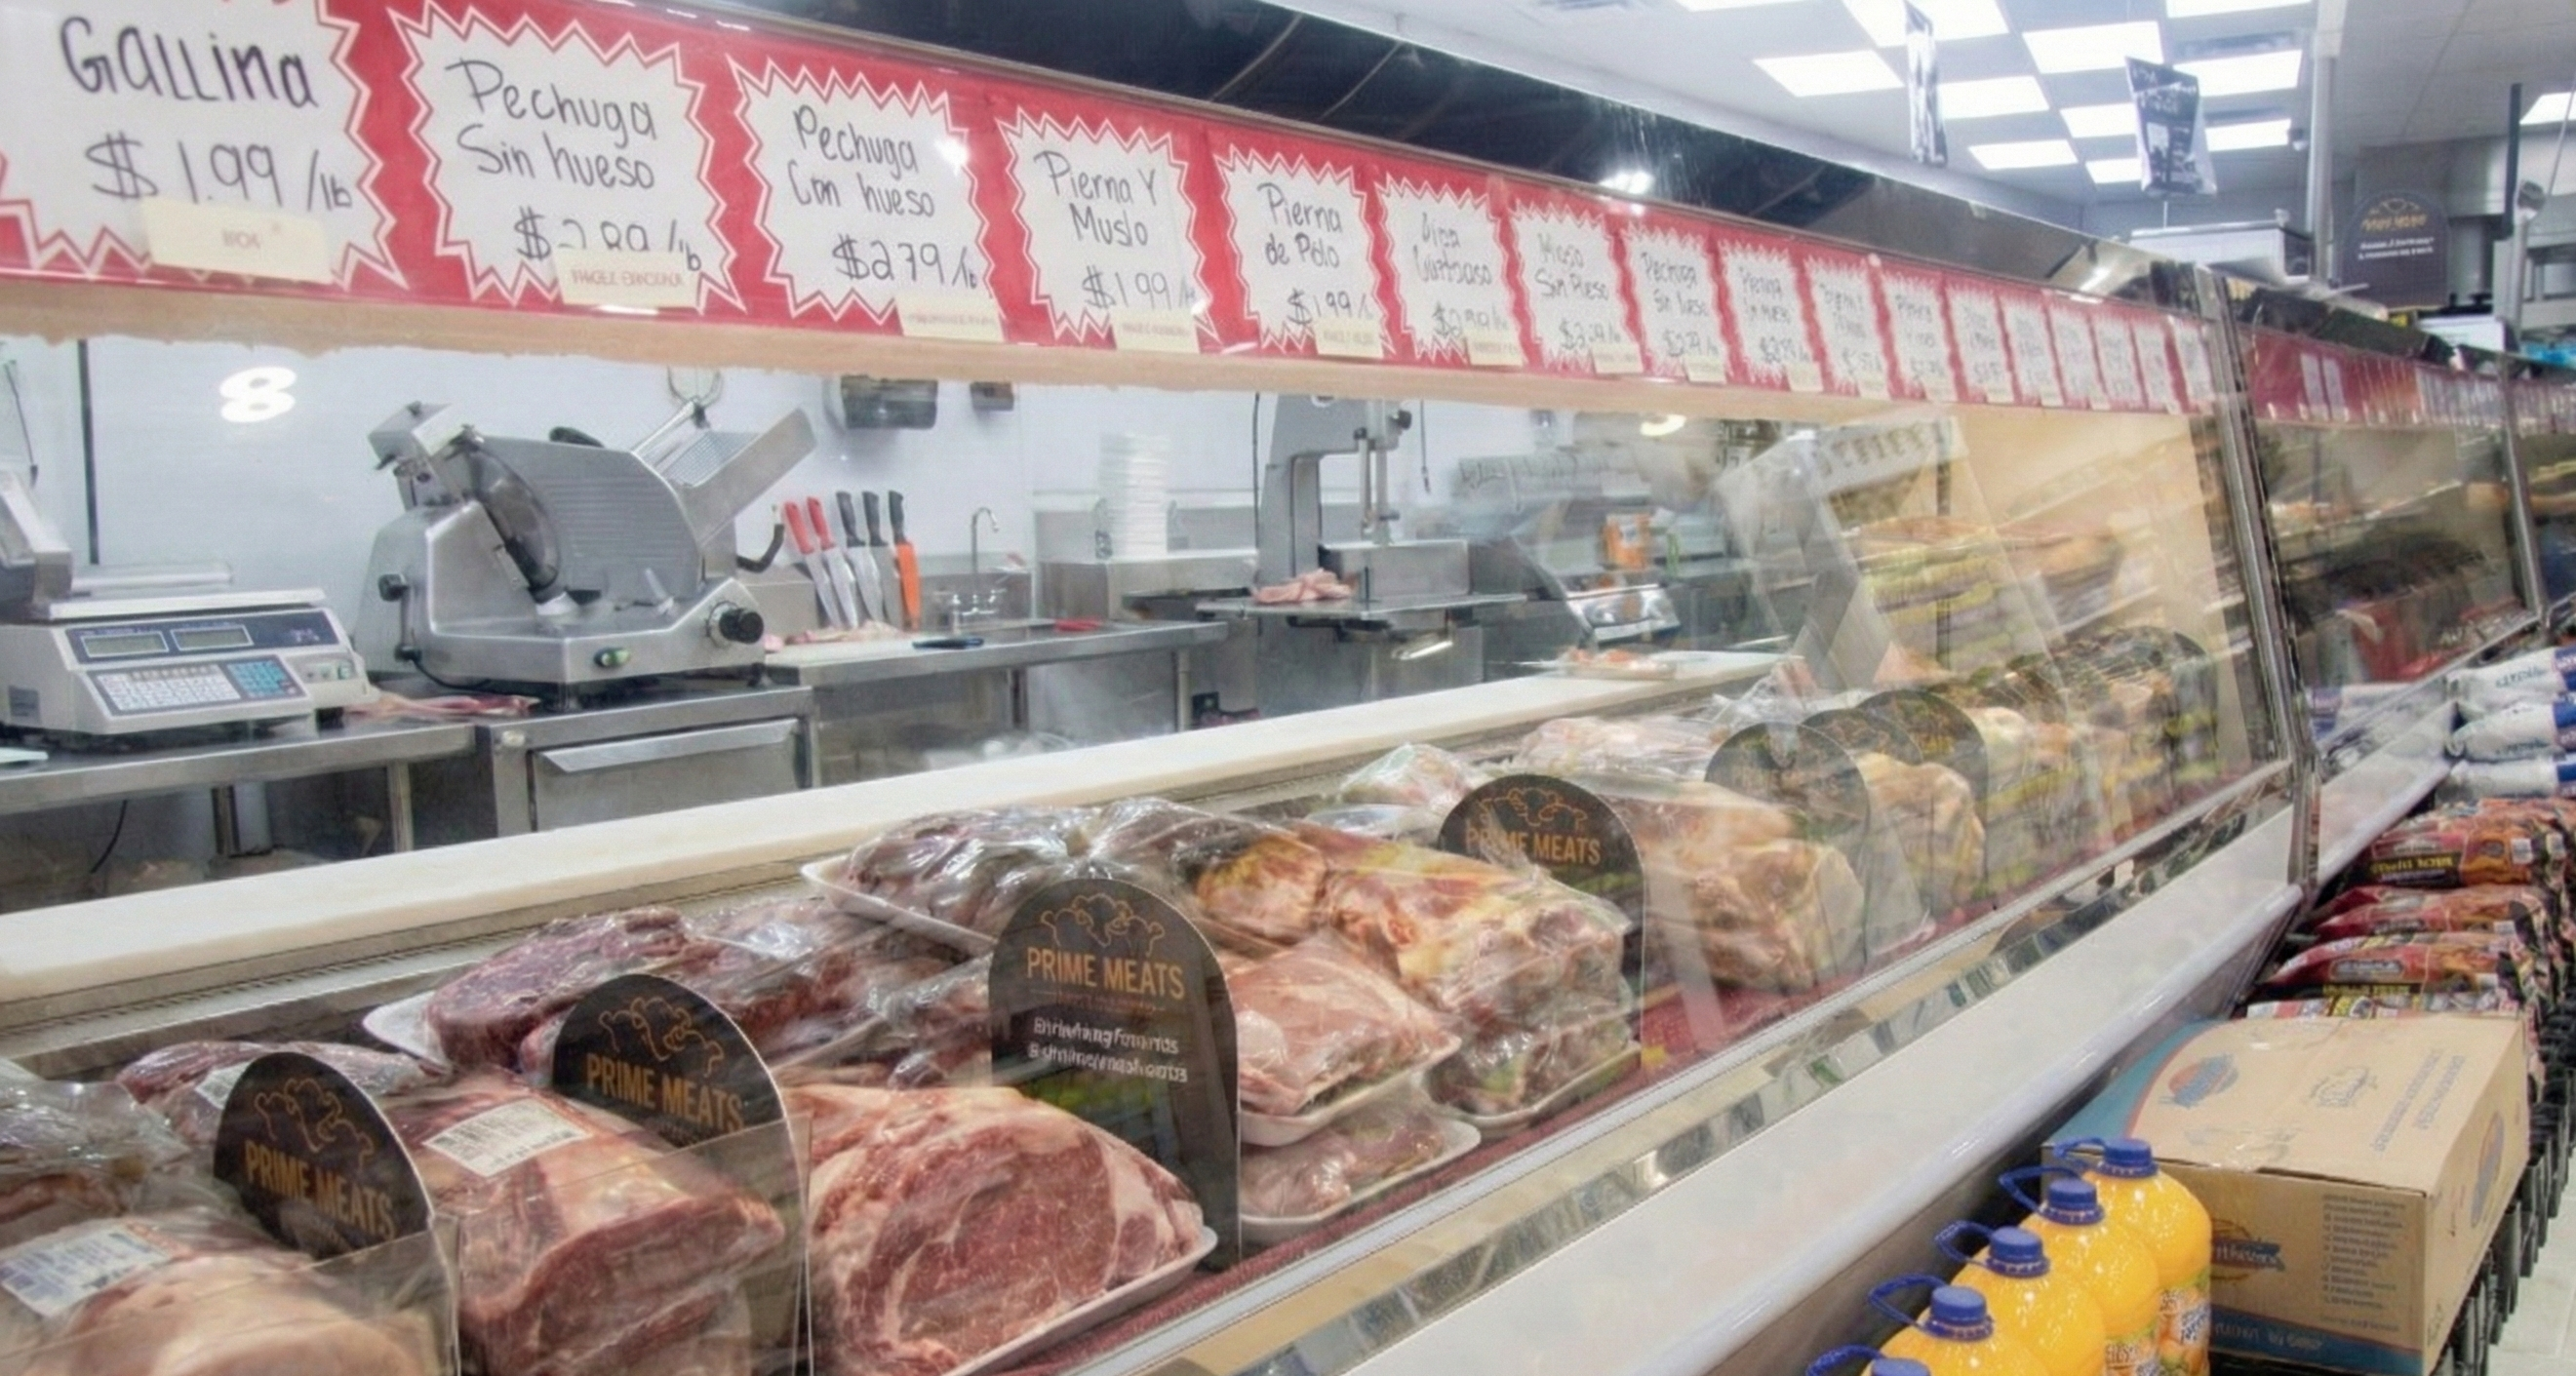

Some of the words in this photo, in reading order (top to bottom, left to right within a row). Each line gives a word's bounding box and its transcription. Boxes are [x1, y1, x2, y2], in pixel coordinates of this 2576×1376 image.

[444, 57, 658, 150] Pechuga
[456, 122, 535, 179] Sin
[542, 131, 656, 190] hueso
[792, 103, 919, 182] Pechuga
[855, 171, 936, 219] hueso
[1033, 149, 1134, 205] Pierna
[1068, 202, 1149, 248] Muslo
[1256, 181, 1344, 234] Pierna
[1264, 232, 1290, 266] de
[1532, 832, 1602, 866] MEATS
[1026, 946, 1098, 989] PRIME
[1102, 955, 1186, 1001] MEATS
[586, 1051, 655, 1111] PRIME
[661, 1073, 744, 1134] MEATS
[245, 1139, 312, 1205] PRIME
[314, 1166, 396, 1242] MEATS
